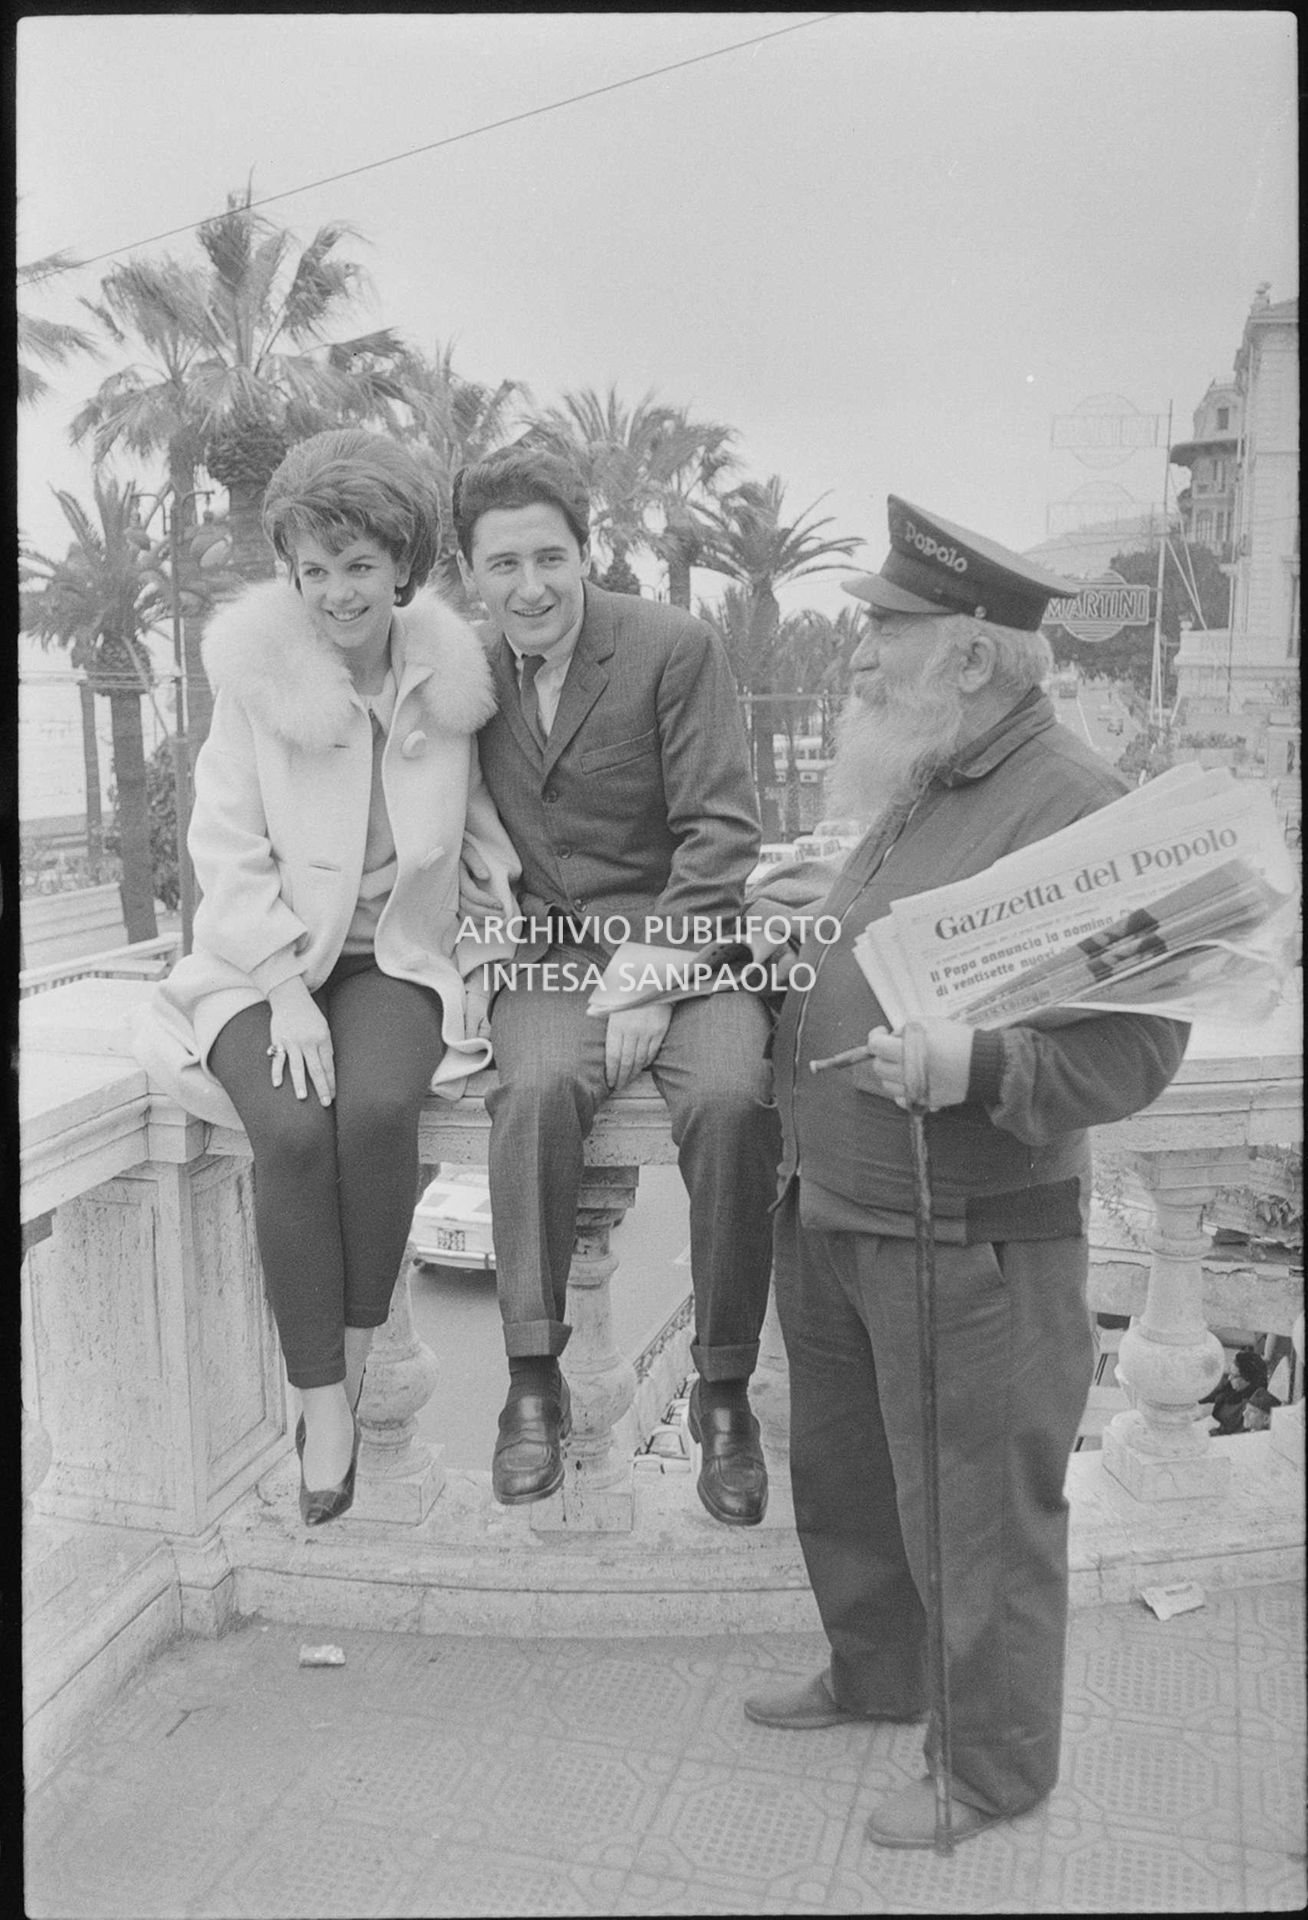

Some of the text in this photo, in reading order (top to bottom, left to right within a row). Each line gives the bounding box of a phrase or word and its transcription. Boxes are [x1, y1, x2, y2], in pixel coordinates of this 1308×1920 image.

[1046, 590, 1148, 619] MARTINI
[934, 876, 1065, 941] Gazzetta
[1074, 863, 1121, 906] del
[1130, 827, 1239, 878] Popolo
[929, 969, 941, 984] Il
[944, 957, 978, 981] Papa
[981, 937, 1044, 968] annuncia
[1045, 929, 1060, 947] la
[935, 982, 949, 998] di
[952, 960, 1016, 991] ventisette
